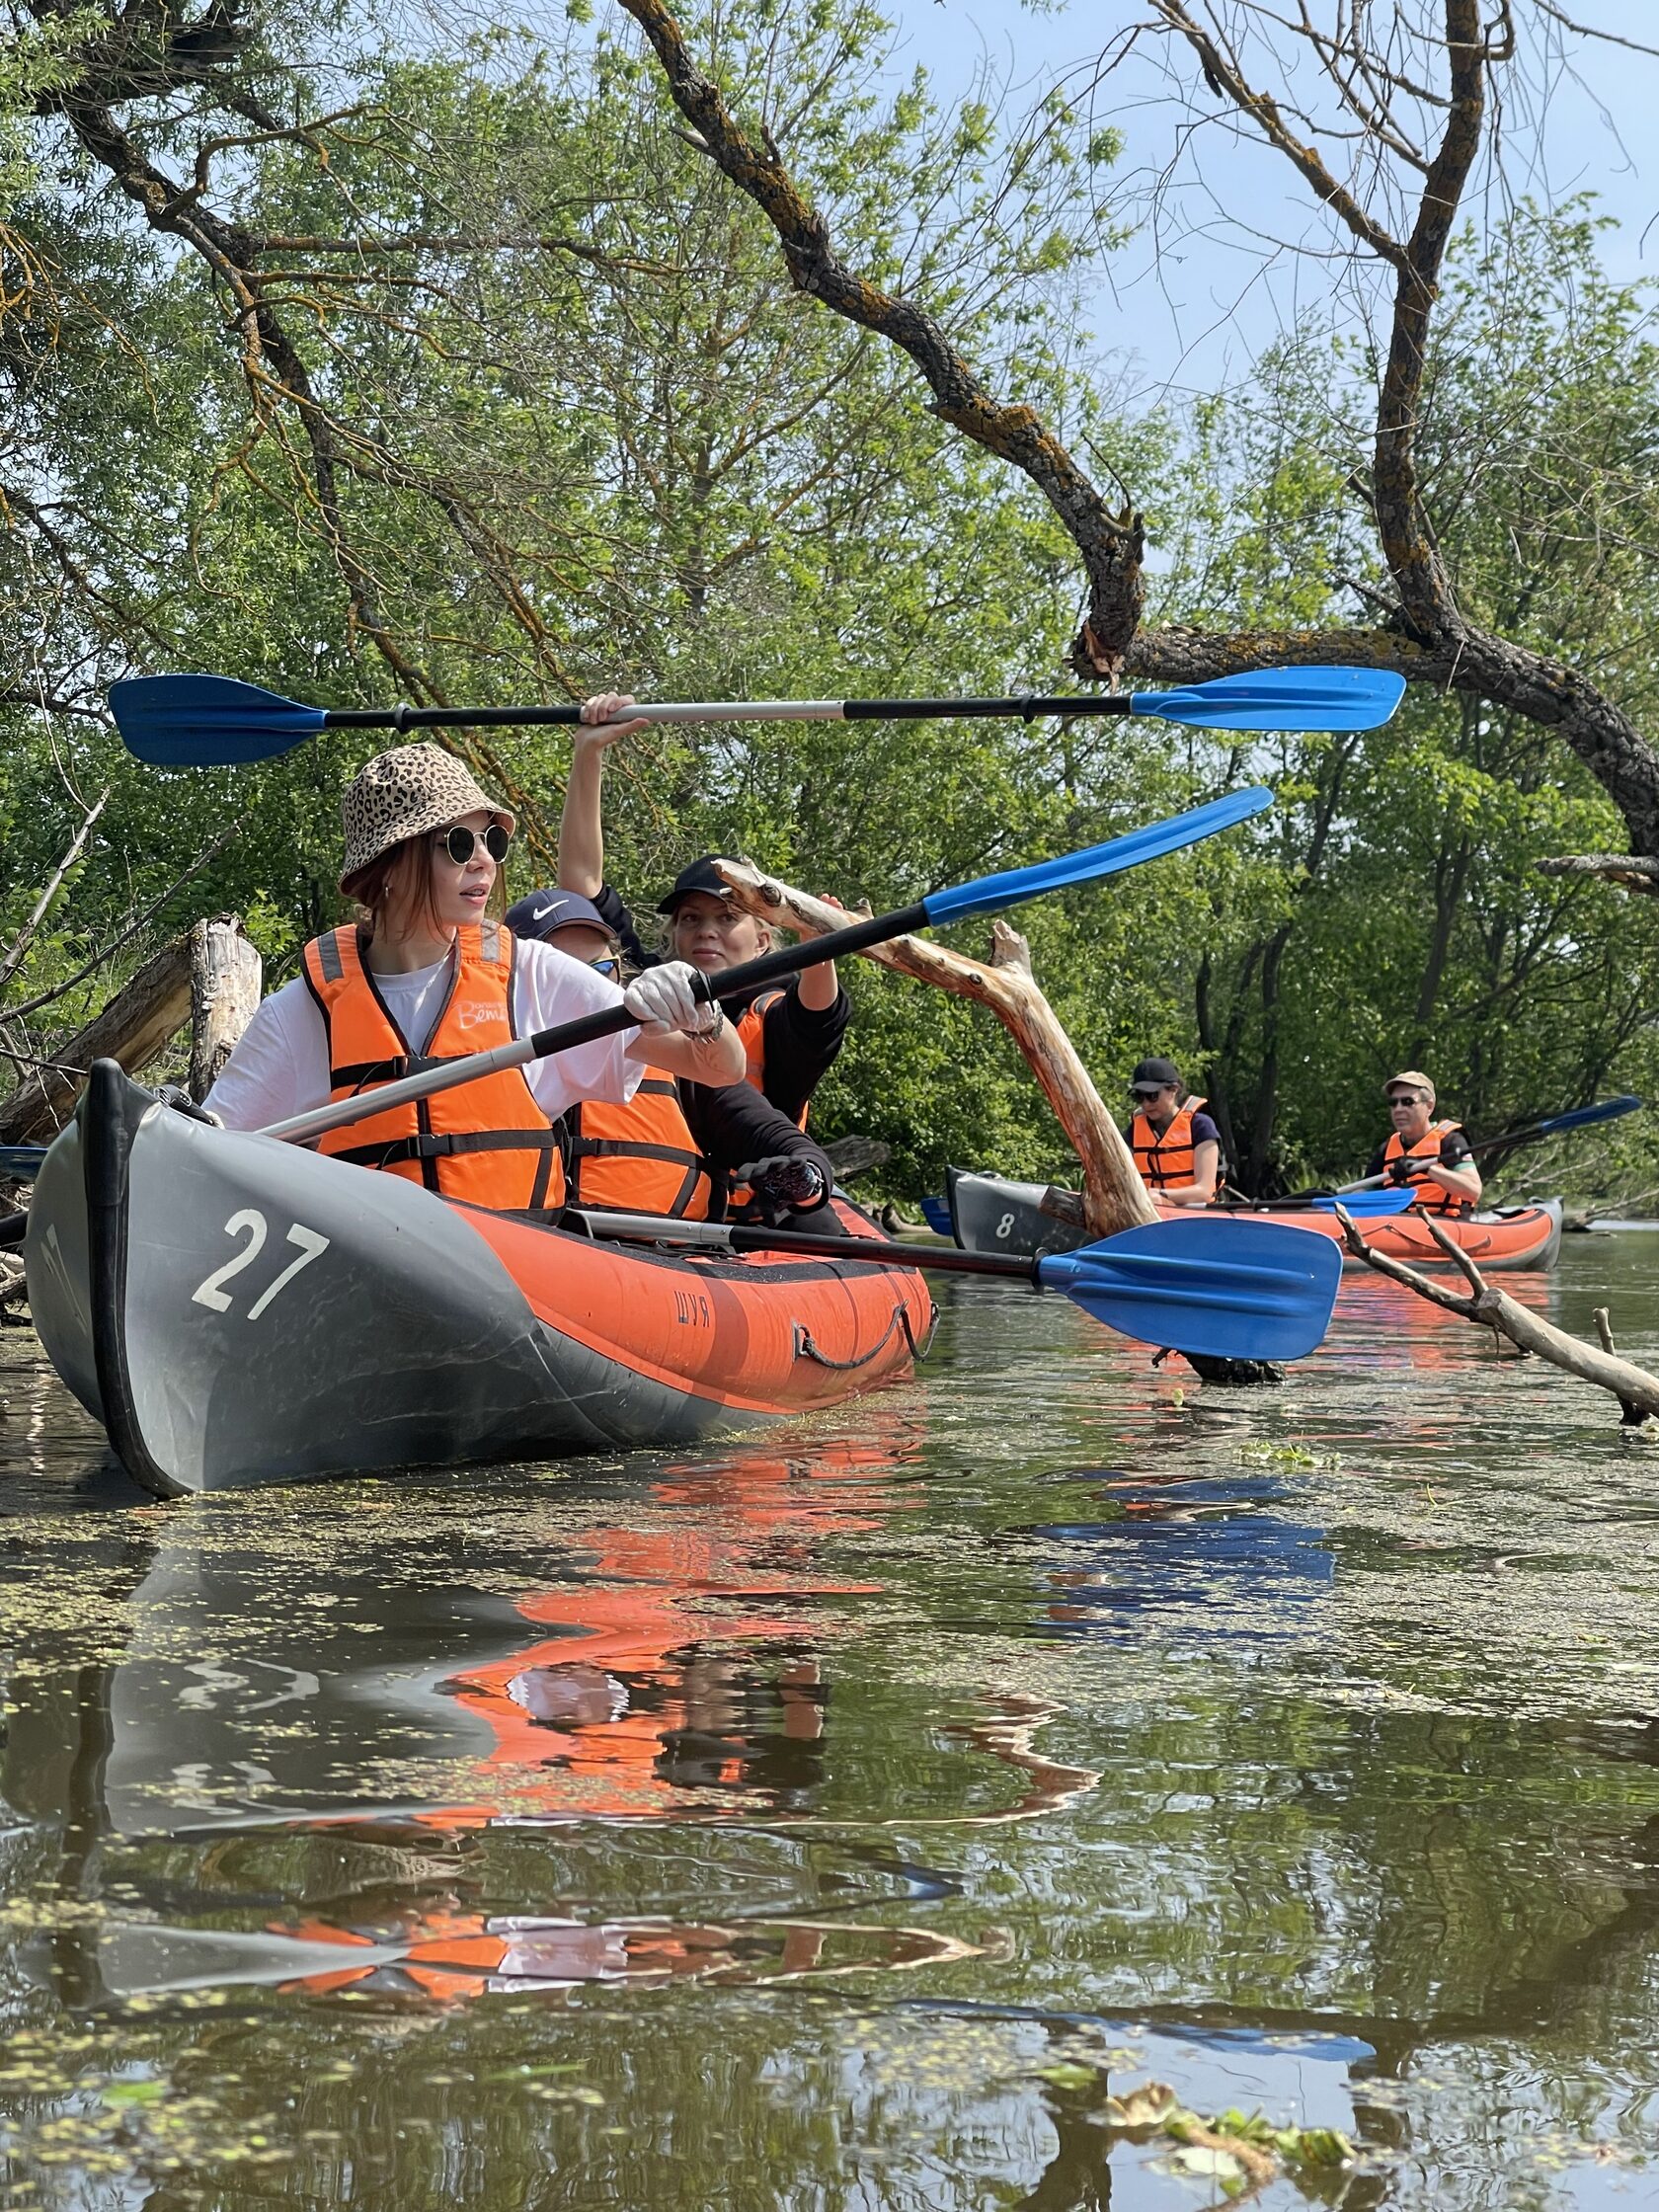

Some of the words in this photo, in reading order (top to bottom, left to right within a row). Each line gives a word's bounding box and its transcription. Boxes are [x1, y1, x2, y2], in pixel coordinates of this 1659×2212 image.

[995, 1213, 1015, 1238] 8
[192, 1209, 331, 1320] 27
[673, 1290, 710, 1327] ШУЯ
